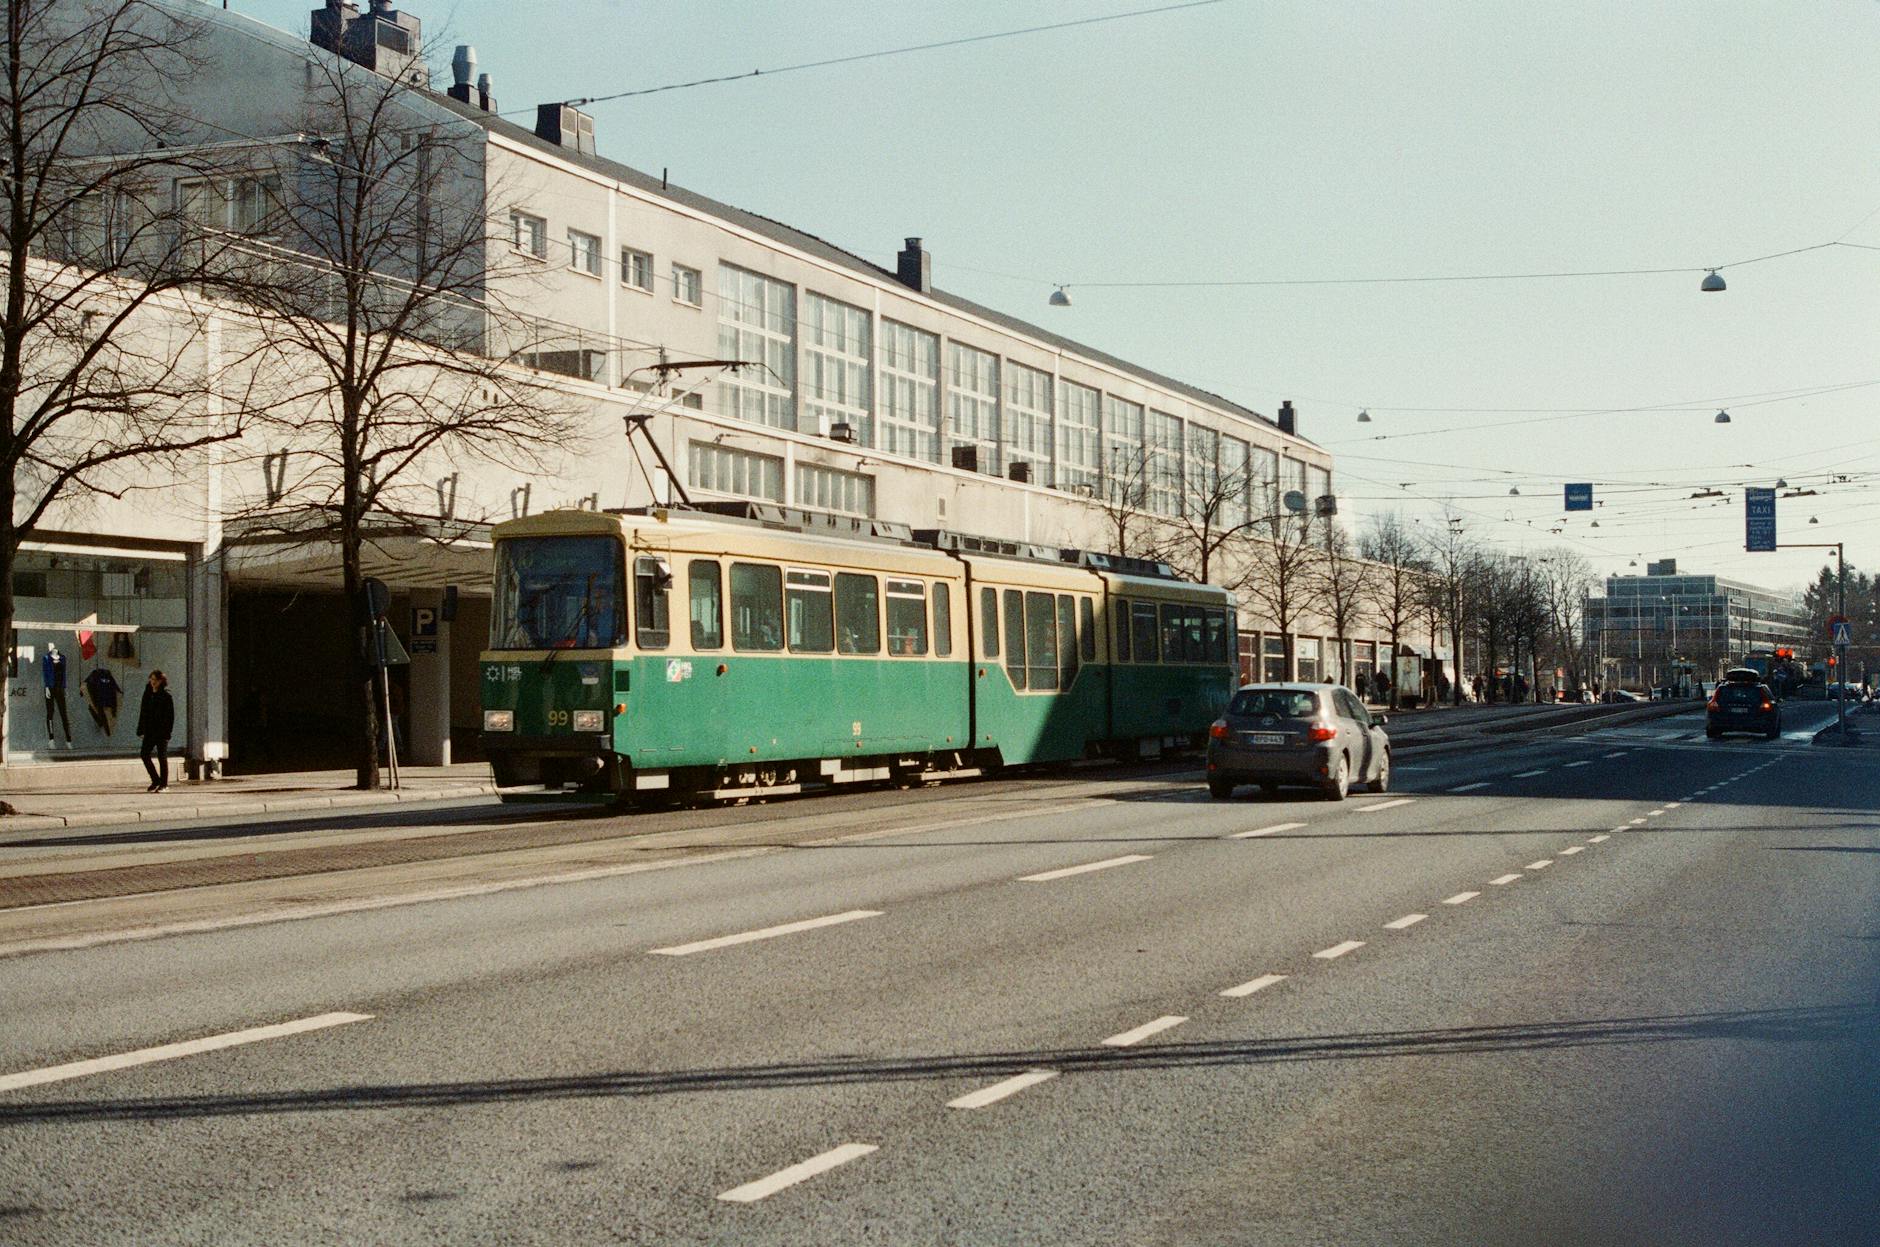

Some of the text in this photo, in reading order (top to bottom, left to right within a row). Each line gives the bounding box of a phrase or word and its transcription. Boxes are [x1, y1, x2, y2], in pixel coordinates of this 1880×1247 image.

[1751, 505, 1771, 514] TAXI
[416, 609, 433, 634] P
[548, 710, 568, 726] 99
